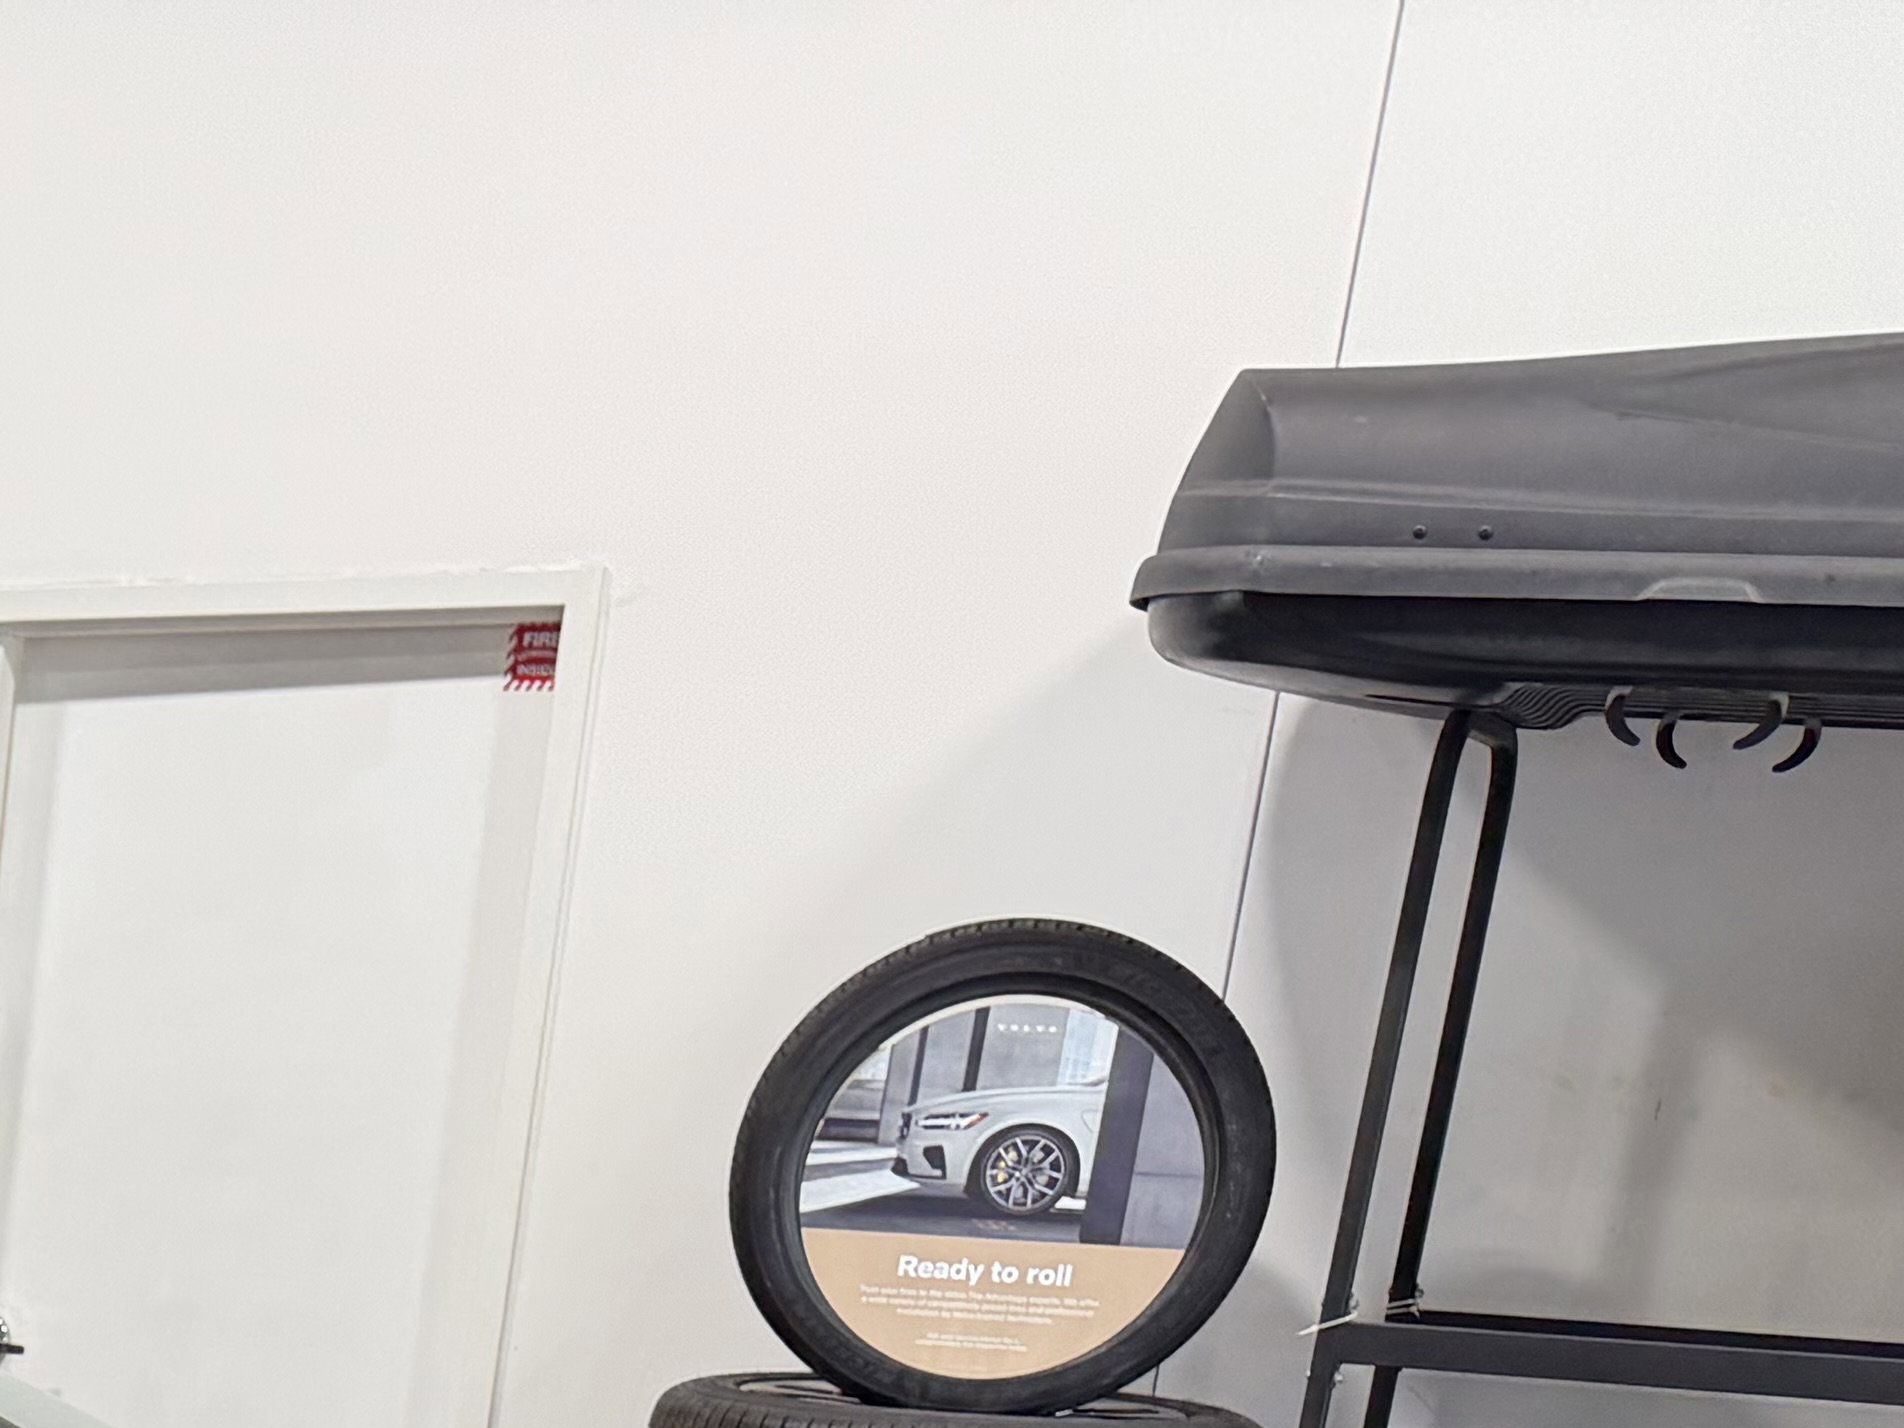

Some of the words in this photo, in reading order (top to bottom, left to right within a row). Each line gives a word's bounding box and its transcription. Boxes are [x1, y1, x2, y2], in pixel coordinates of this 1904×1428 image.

[897, 1254, 984, 1287] Ready
[991, 1261, 1019, 1284] to
[1026, 1263, 1073, 1287] roll
